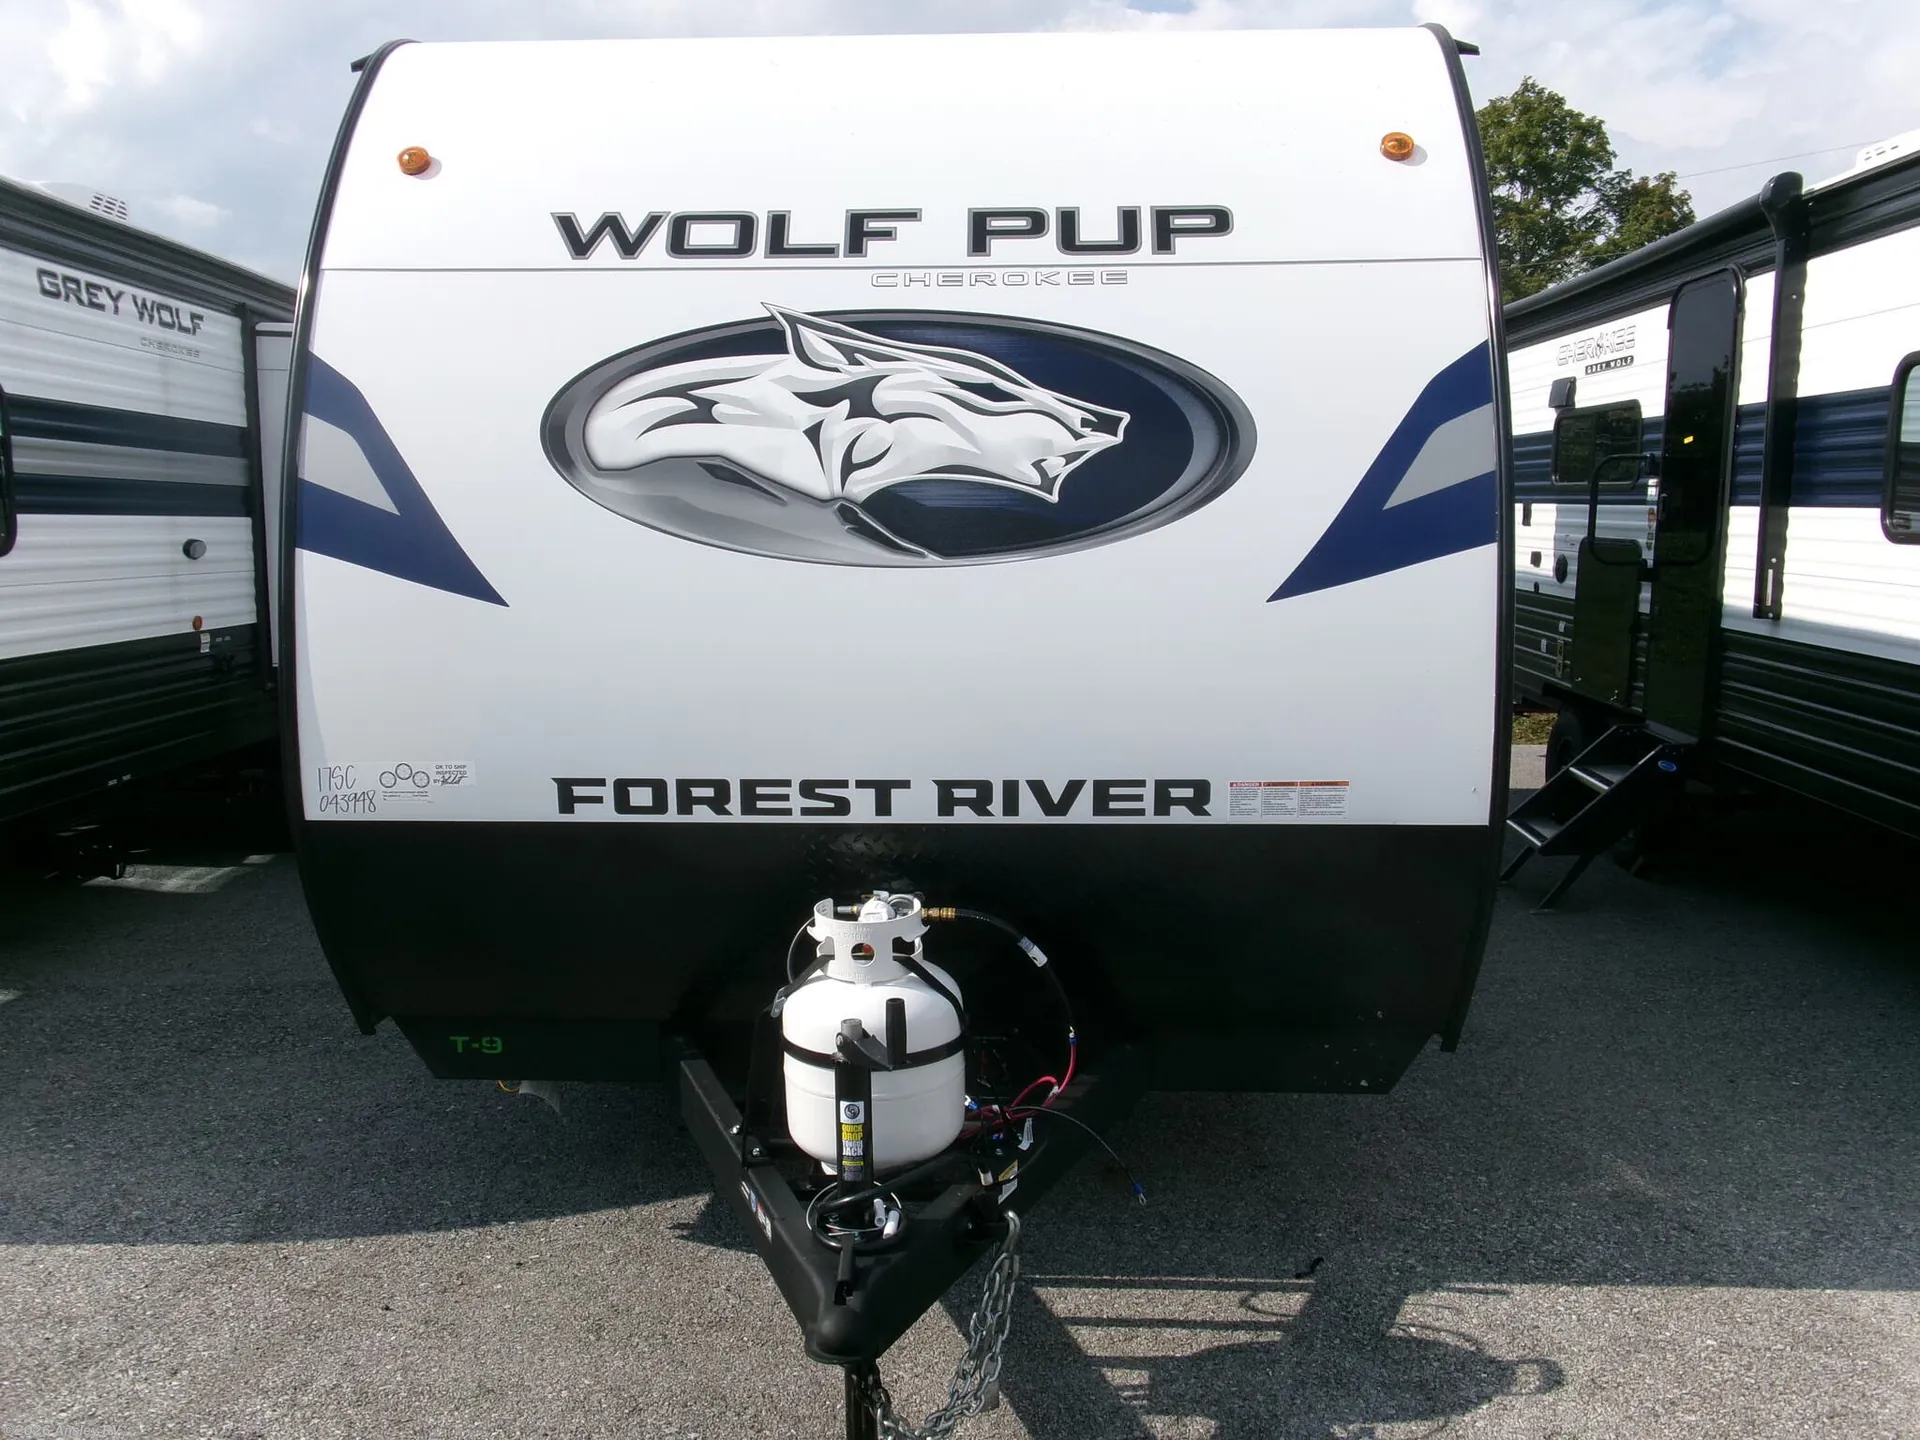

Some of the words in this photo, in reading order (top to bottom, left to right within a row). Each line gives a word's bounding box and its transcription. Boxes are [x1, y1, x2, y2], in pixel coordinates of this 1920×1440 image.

[550, 204, 922, 260] WOLF
[967, 204, 1234, 257] PUP
[871, 269, 1128, 288] CHEROKEE
[37, 268, 125, 316] GREY
[131, 293, 204, 336] WOLF
[1586, 362, 1606, 374] GREY
[1610, 356, 1632, 368] WOLF
[317, 764, 357, 793] 17SC
[319, 789, 377, 815] 043948
[550, 778, 911, 817] FOREST
[931, 779, 1212, 817] RIVER
[449, 1036, 503, 1053] T-9
[842, 1124, 863, 1133] QUICK
[842, 1132, 863, 1141] DROP
[842, 1147, 863, 1156] JACK
